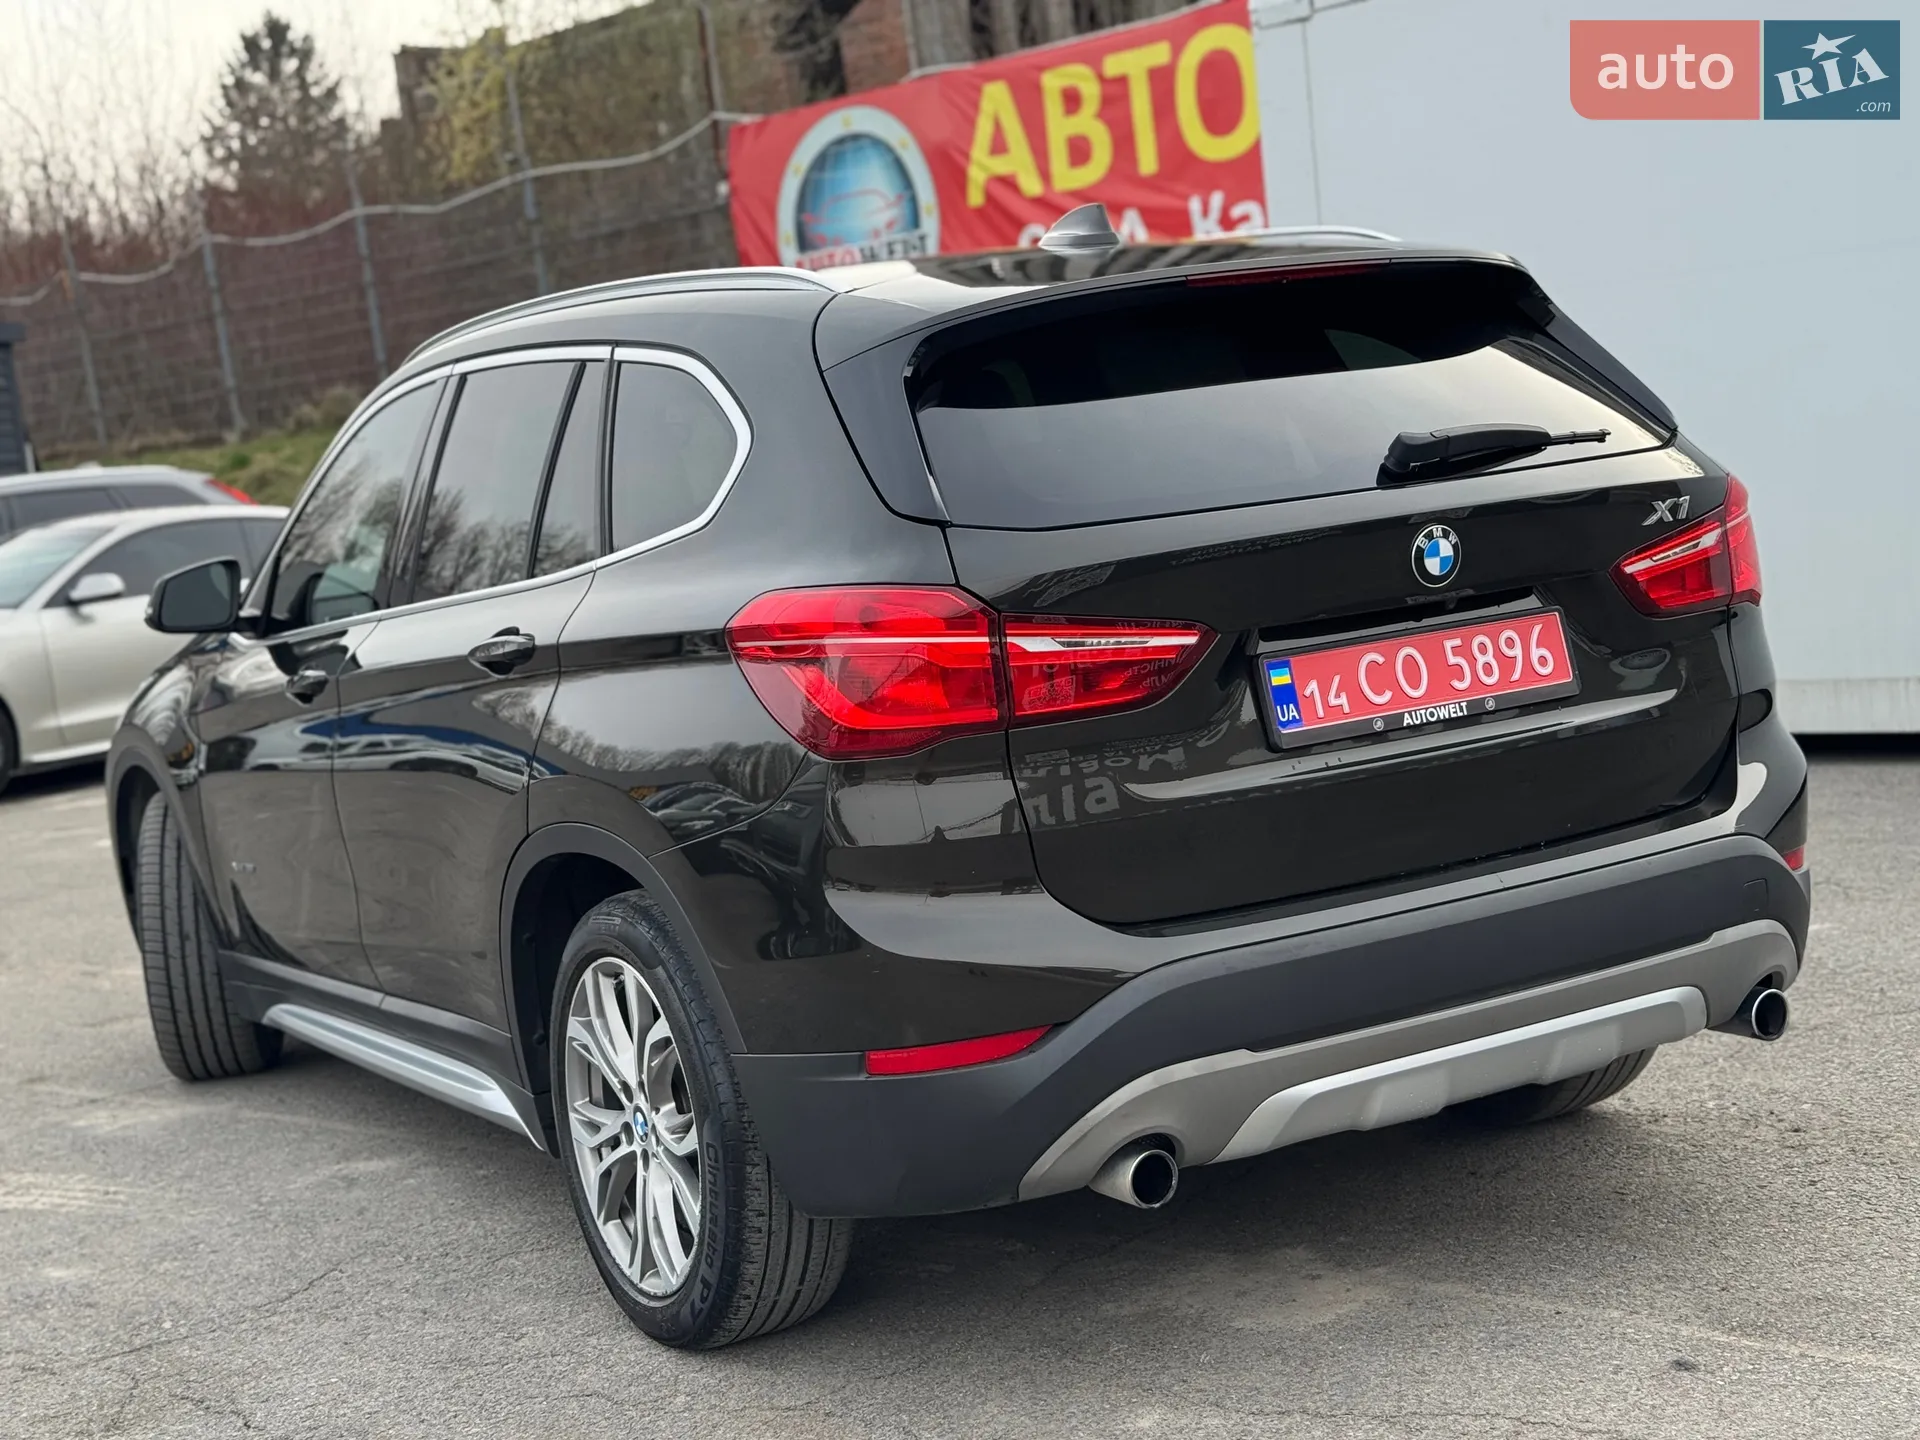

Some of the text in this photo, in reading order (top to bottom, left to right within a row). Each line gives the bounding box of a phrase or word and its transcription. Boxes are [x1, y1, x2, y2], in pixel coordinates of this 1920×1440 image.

[966, 23, 1261, 208] АВТО
[1642, 495, 1691, 527] X1
[1417, 527, 1458, 550] BMW
[1303, 624, 1554, 719] 14 CO 5896
[1277, 702, 1300, 722] UA
[1402, 701, 1468, 727] AUTOWELT
